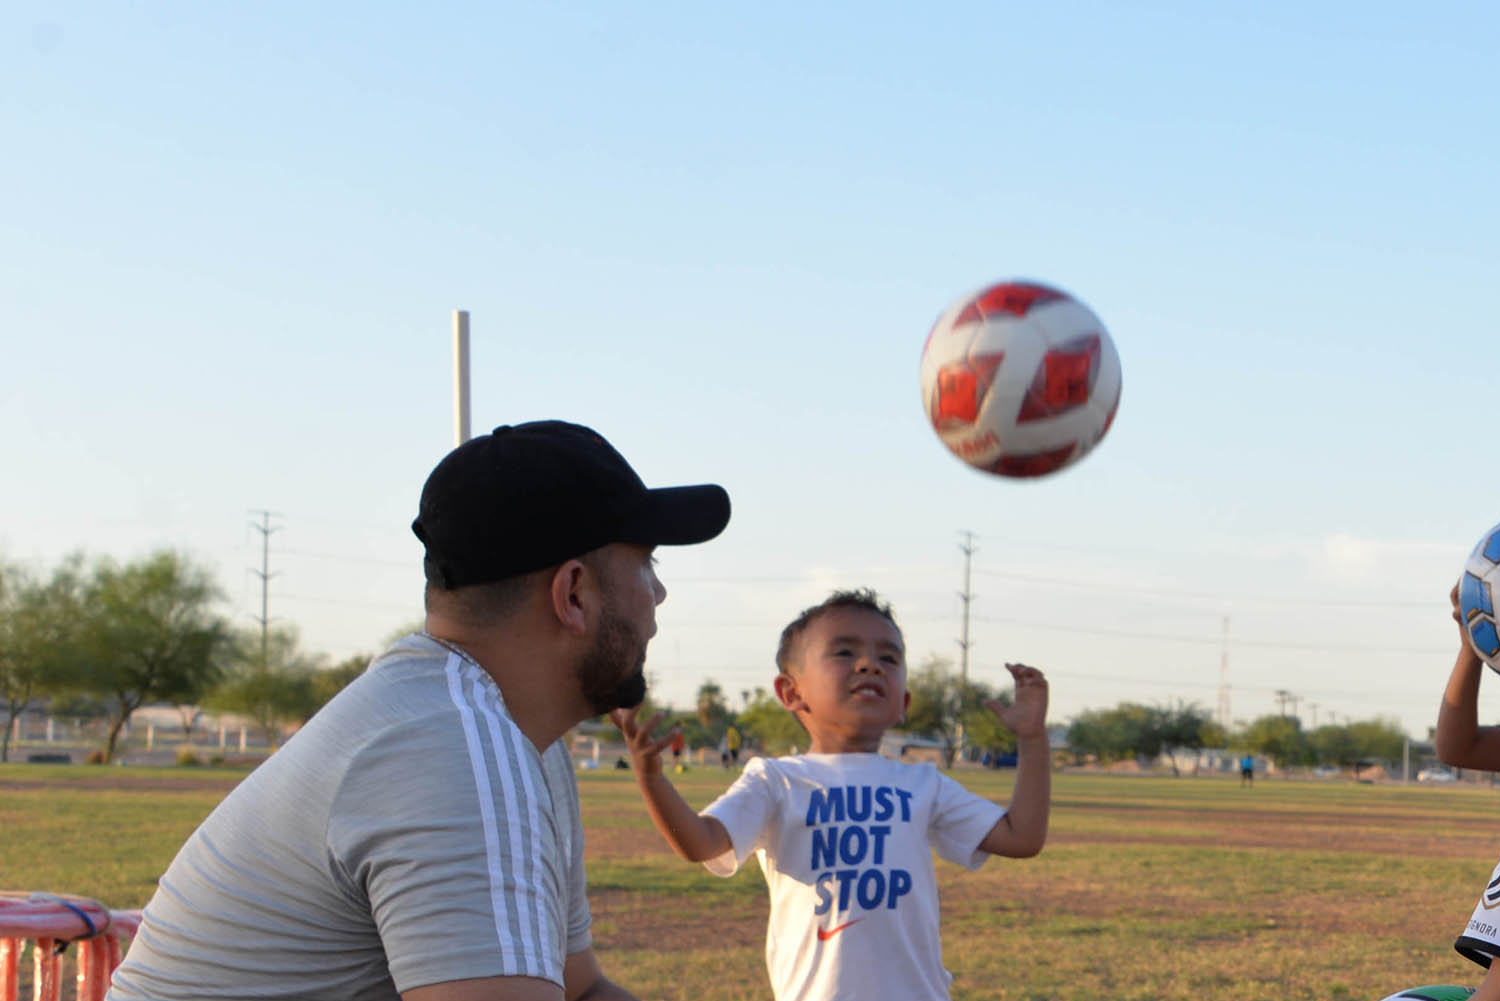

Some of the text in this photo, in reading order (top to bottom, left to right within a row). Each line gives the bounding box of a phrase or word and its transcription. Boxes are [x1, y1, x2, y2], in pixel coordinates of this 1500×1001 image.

[806, 786, 912, 827] MUST
[811, 826, 891, 870] NOT
[815, 869, 912, 915] STOP
